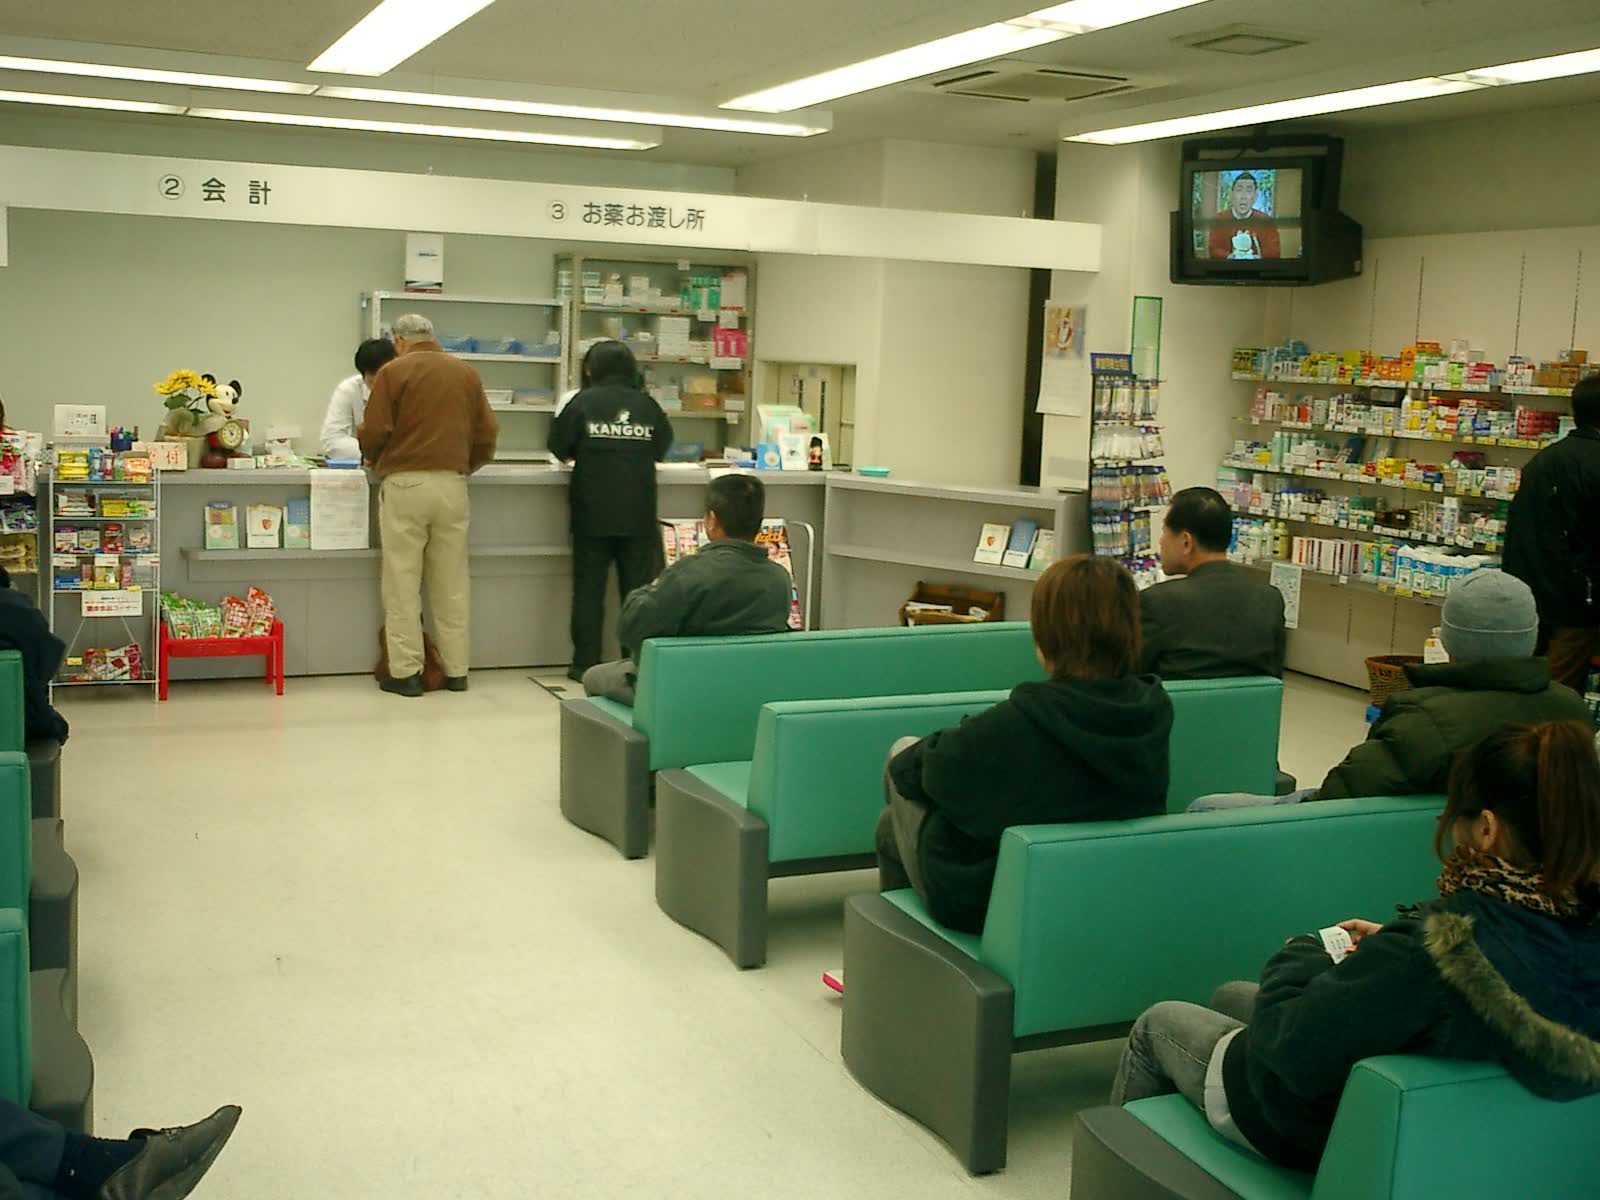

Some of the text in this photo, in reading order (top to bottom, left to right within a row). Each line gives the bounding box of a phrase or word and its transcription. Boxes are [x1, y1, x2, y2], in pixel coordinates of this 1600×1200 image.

[202, 177, 272, 206] 会計
[582, 201, 706, 231] お薬お渡し所
[588, 423, 653, 438] KANGOL
